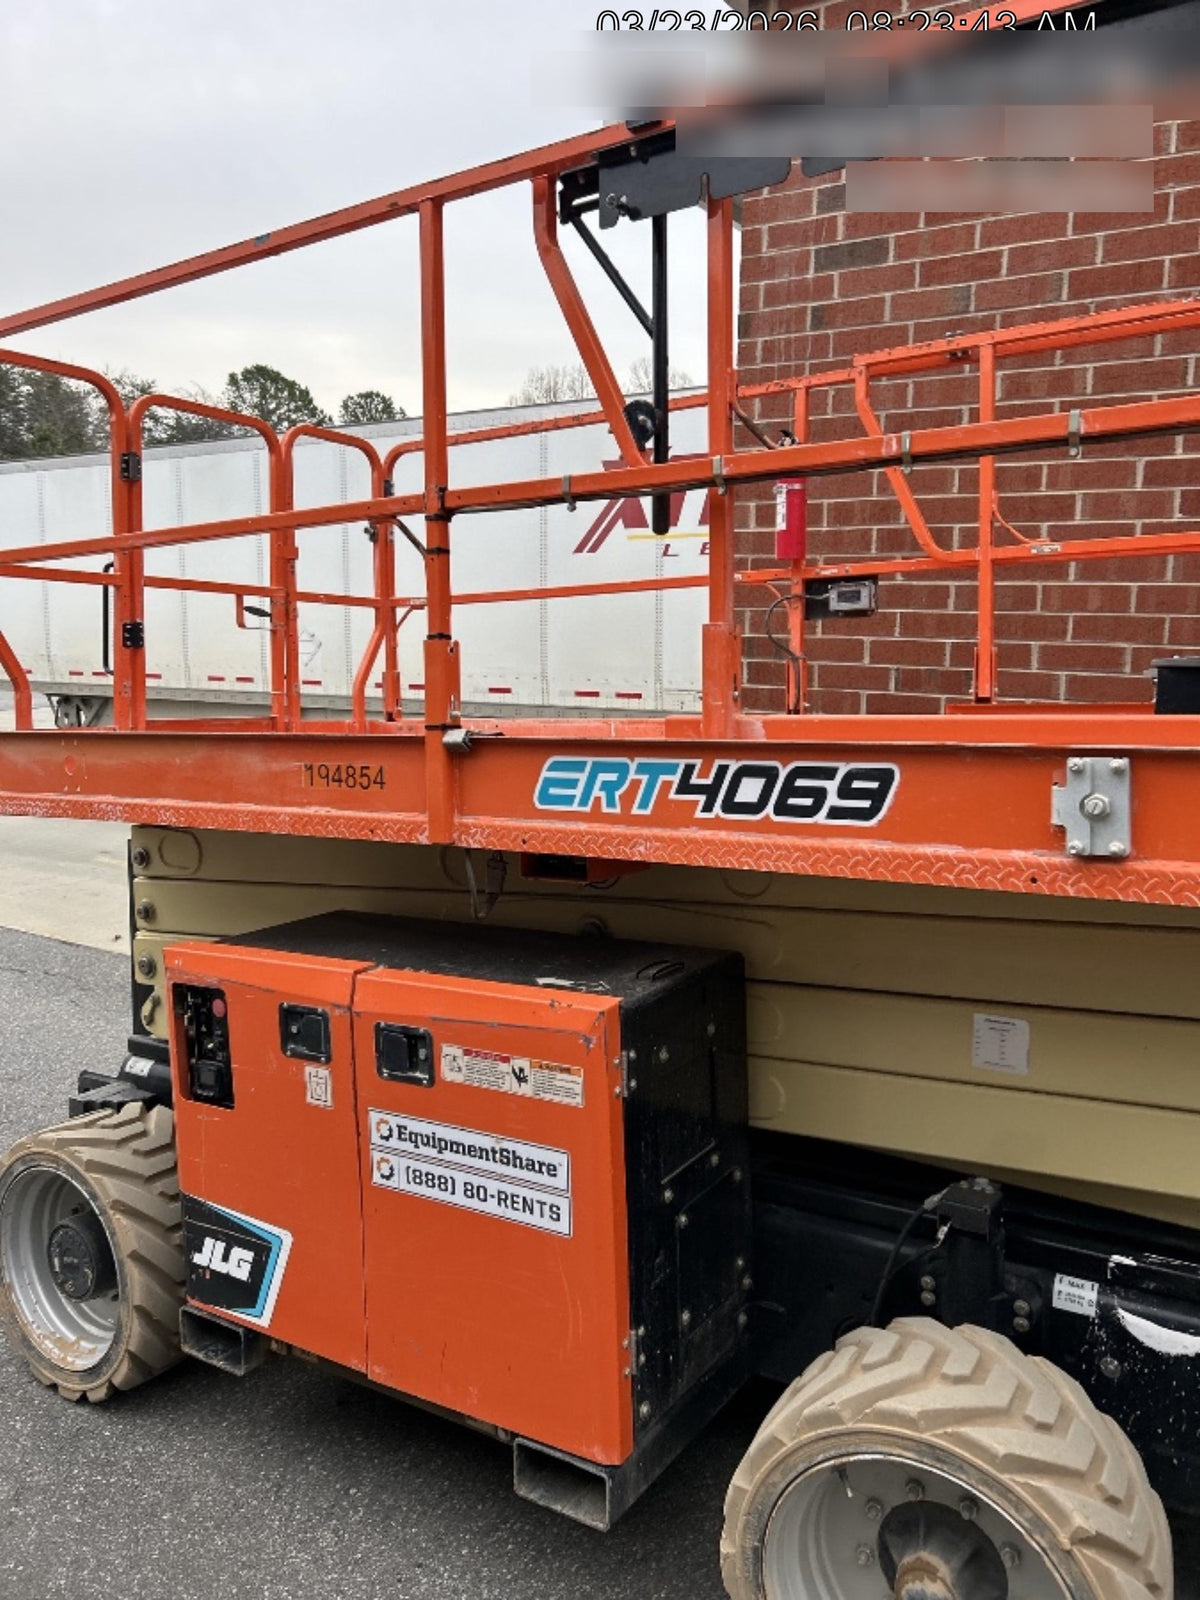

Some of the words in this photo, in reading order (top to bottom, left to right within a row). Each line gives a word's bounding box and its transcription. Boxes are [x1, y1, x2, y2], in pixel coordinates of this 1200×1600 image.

[304, 763, 386, 790] 194854
[535, 756, 899, 825] ERT4069
[396, 1124, 558, 1178] EquipmentShare
[406, 1166, 456, 1195] (888)
[463, 1181, 561, 1222] 80-RENTS
[192, 1237, 254, 1282] JLG
